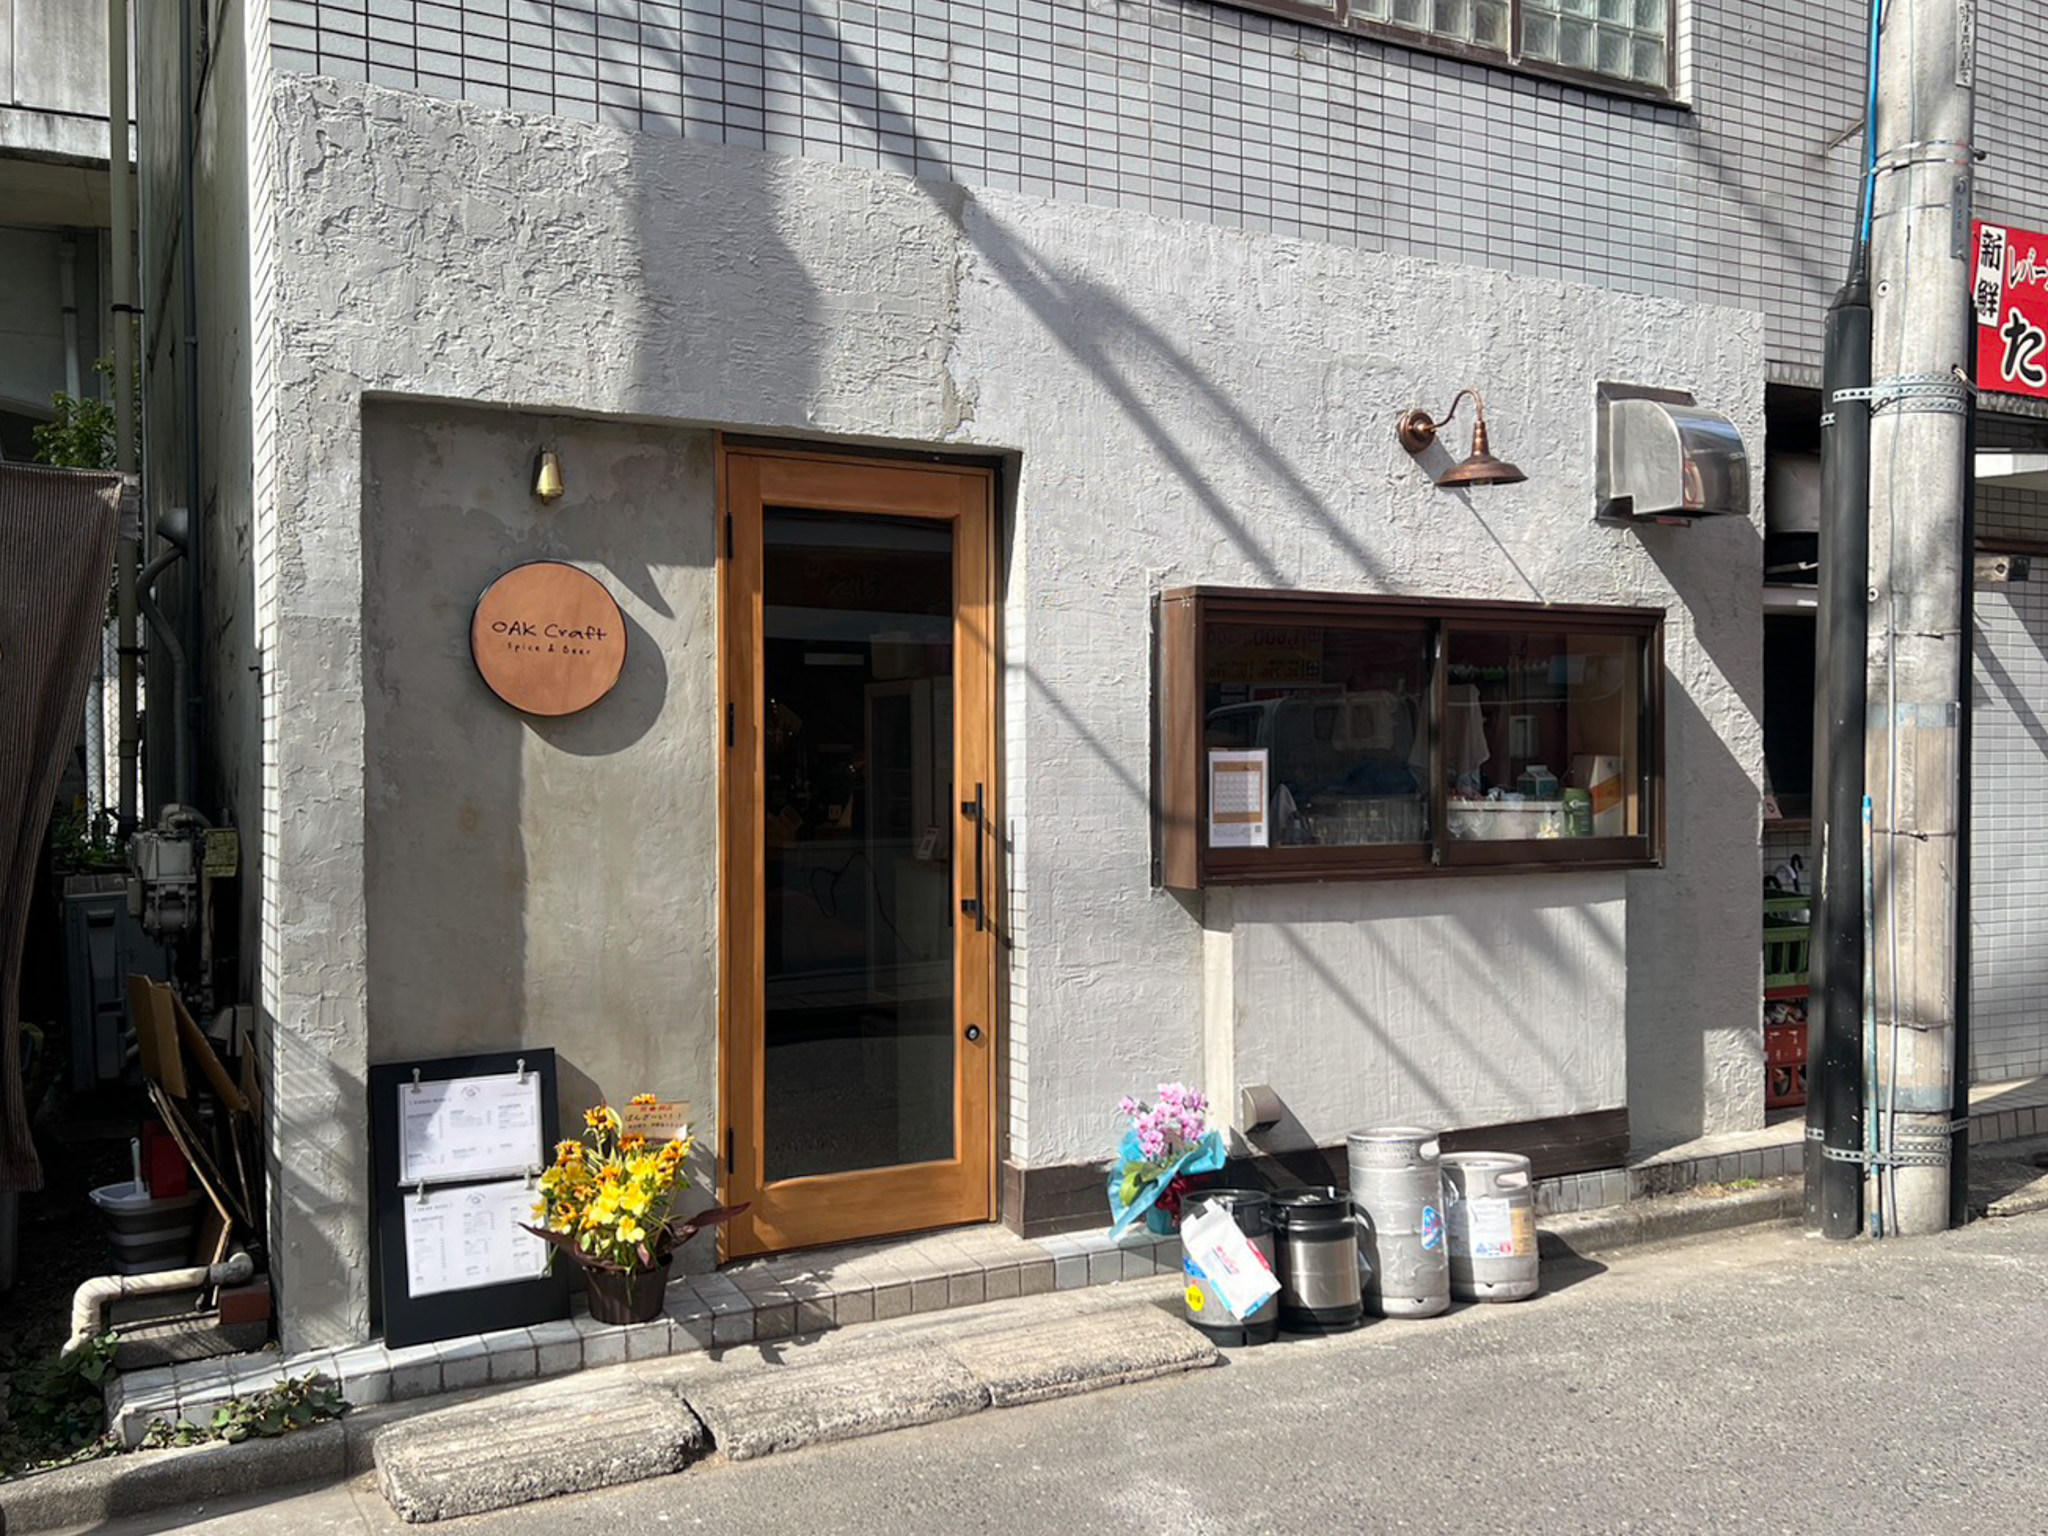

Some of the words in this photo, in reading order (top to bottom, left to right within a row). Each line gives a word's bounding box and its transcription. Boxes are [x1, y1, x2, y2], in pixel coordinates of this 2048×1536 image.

[1978, 229, 2003, 318] 新鮮
[2007, 245, 2048, 290] レバー
[491, 621, 537, 636] OAK
[544, 623, 607, 641] Craft
[507, 641, 540, 653] Spice
[547, 643, 555, 652] &
[562, 645, 591, 655] Beer
